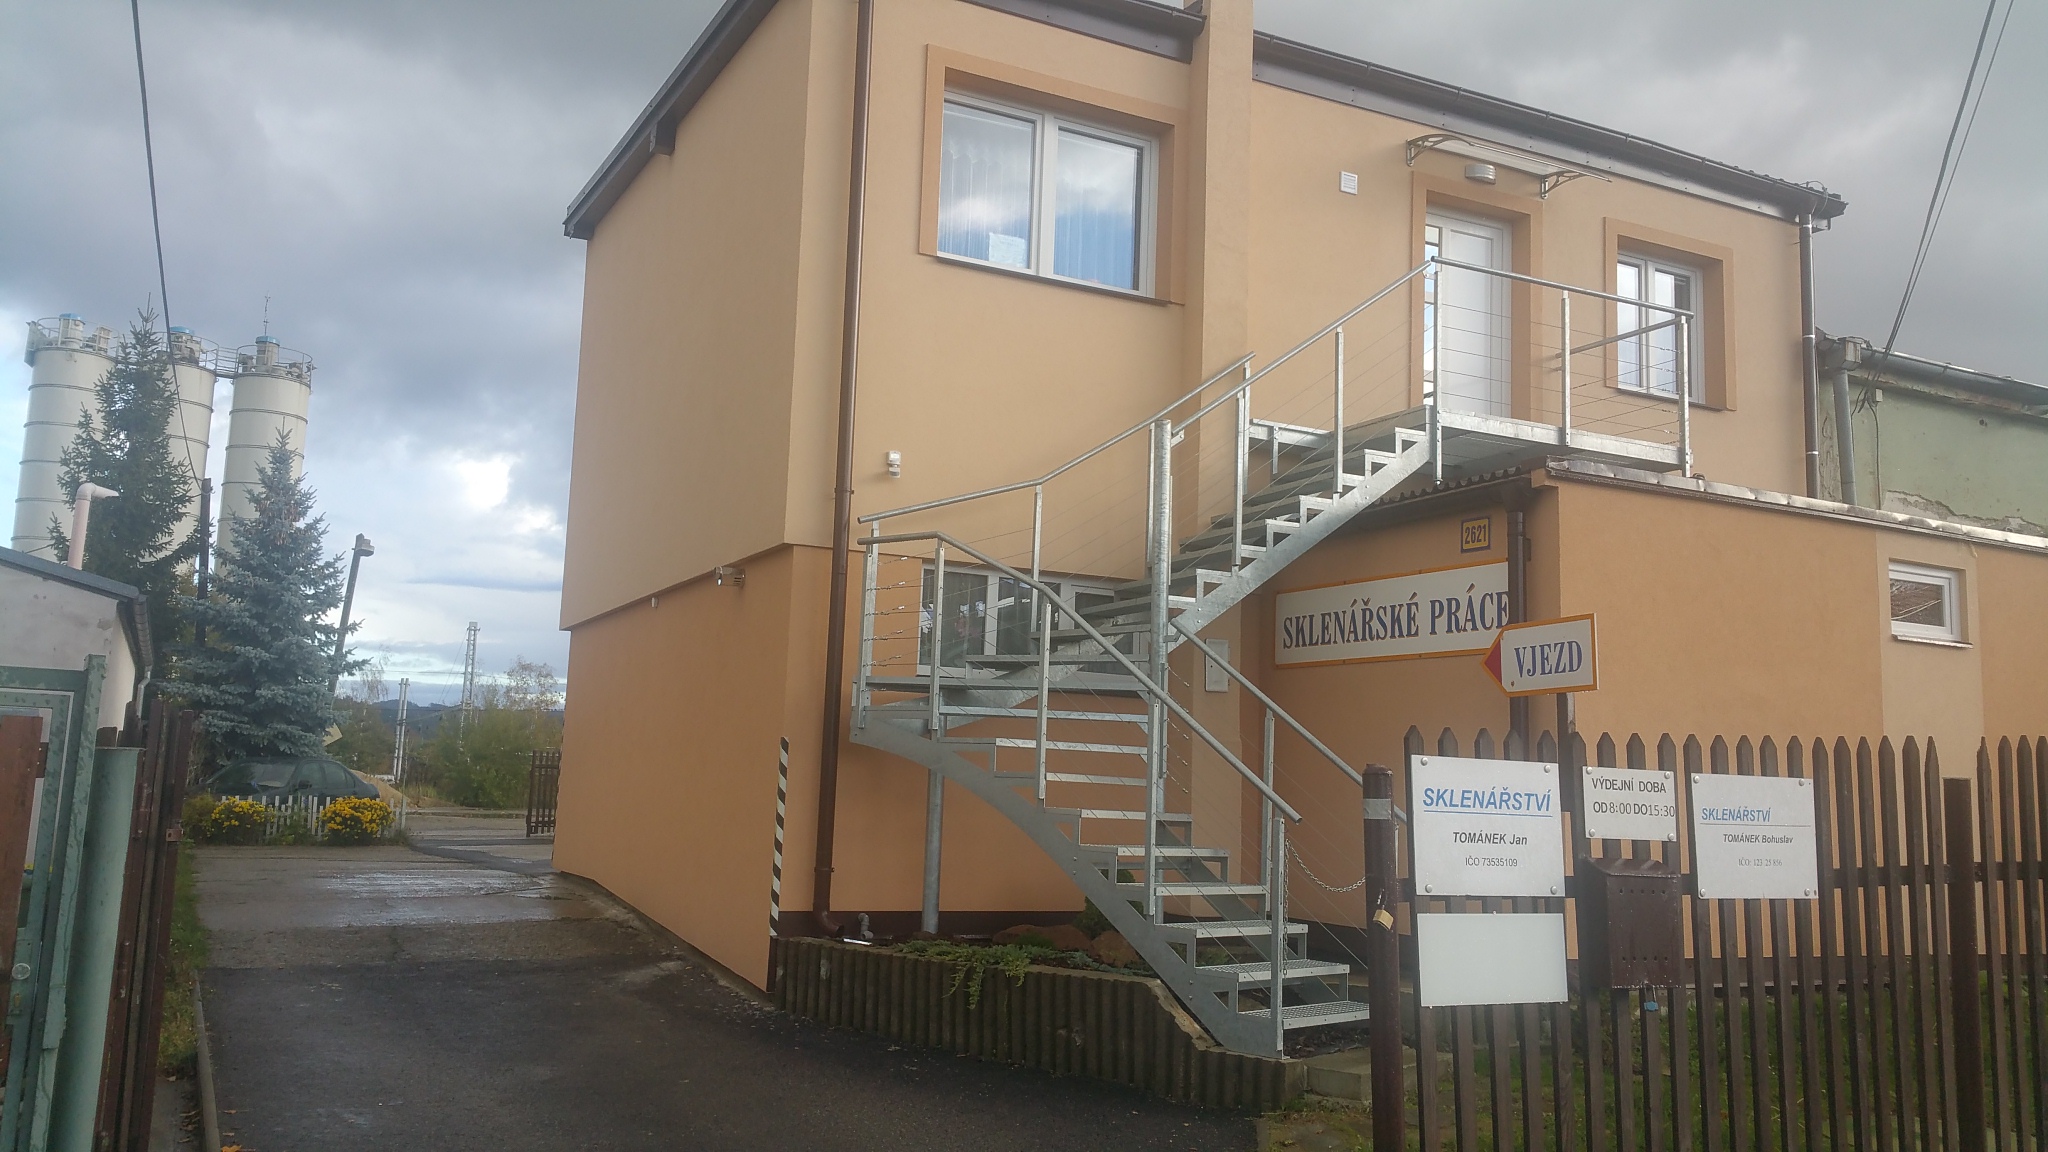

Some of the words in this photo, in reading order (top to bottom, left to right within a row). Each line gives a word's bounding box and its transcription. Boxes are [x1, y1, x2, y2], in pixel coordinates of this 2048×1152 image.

[1464, 524, 1487, 545] 2621
[1283, 591, 1420, 649] SKLENÁŘSKÉ
[1429, 583, 1509, 635] PRÁCE
[1513, 640, 1583, 678] VJEZD
[1591, 776, 1634, 791] VÝDEJNÍ
[1638, 780, 1667, 793] DOBA
[1422, 786, 1552, 812] SKLENÁŘSTVÍ
[1701, 806, 1771, 822] SKLENÁŘSTVÍ
[1453, 830, 1507, 845] TOMÁNEK
[1509, 833, 1528, 845] Jan
[1722, 832, 1760, 843] TOMÁNEK
[1761, 834, 1794, 844] Bohuslav
[1465, 855, 1480, 867] IČO
[1481, 857, 1518, 867] 73535109
